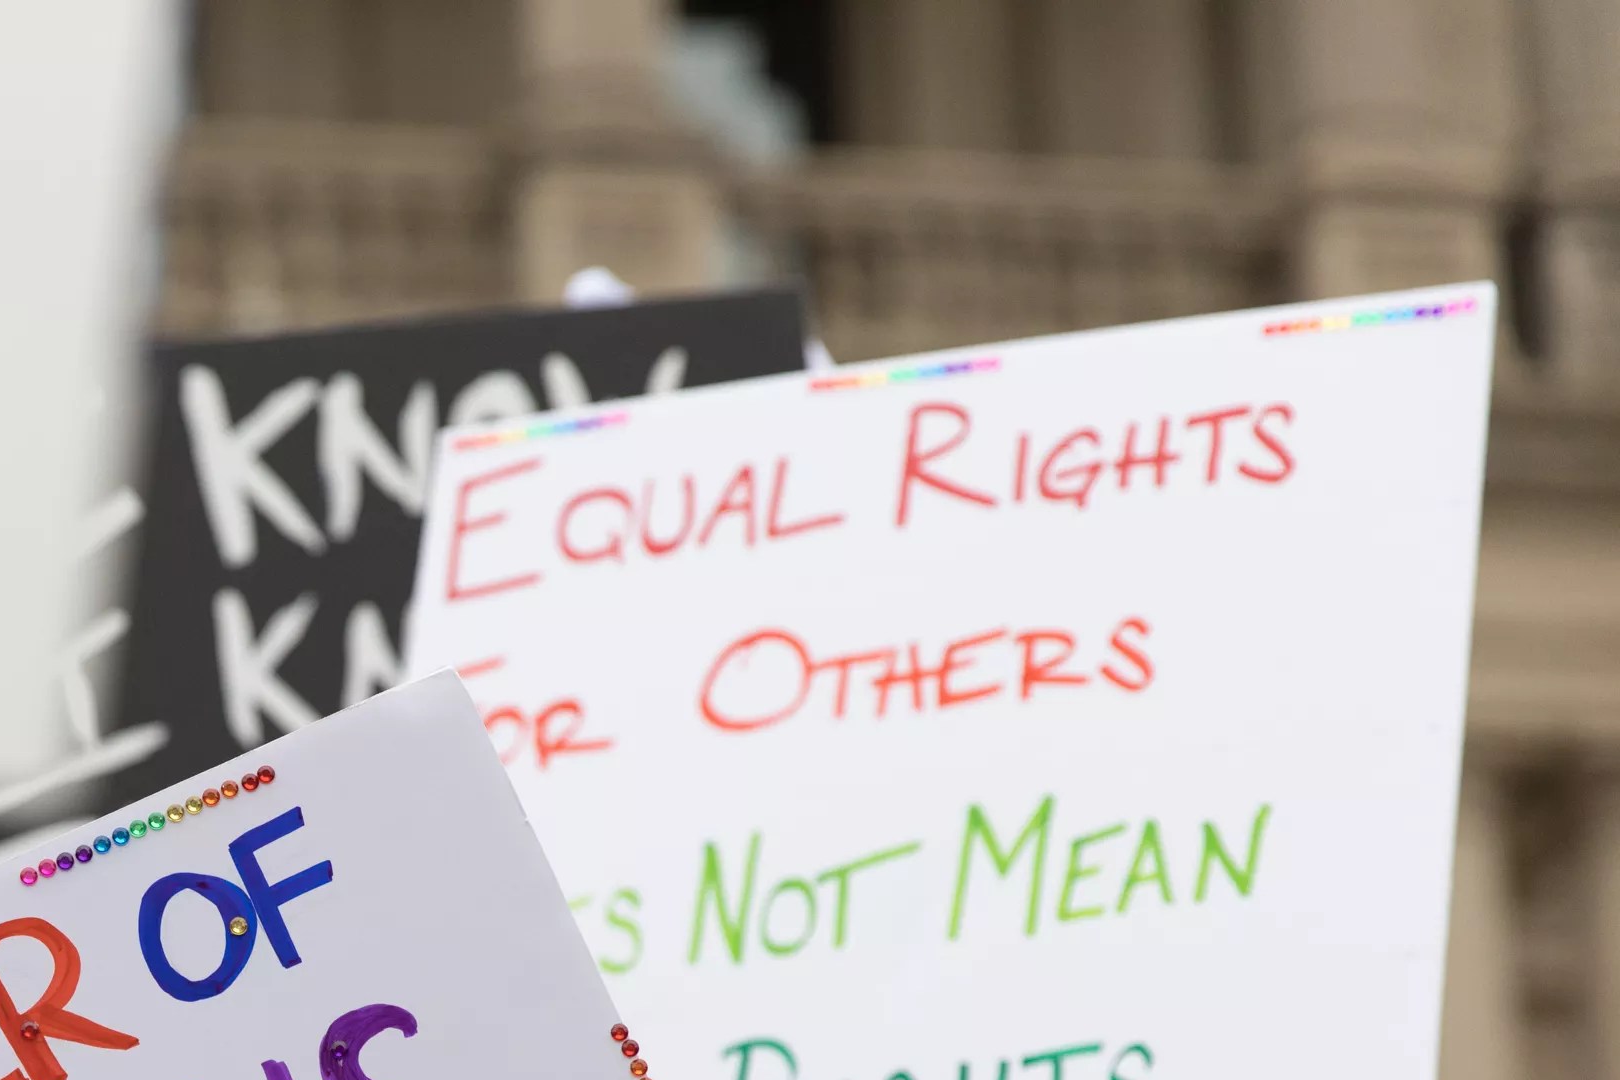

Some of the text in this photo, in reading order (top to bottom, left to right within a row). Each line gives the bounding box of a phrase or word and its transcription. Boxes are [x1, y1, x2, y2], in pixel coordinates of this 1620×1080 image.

[180, 343, 686, 568] KN
[445, 401, 1295, 602] EQUAL RIGHTS
[458, 616, 1155, 770] OR OTHERS
[138, 805, 333, 1003] OF
[686, 830, 923, 966] NOT
[946, 794, 1273, 941] MEAN
